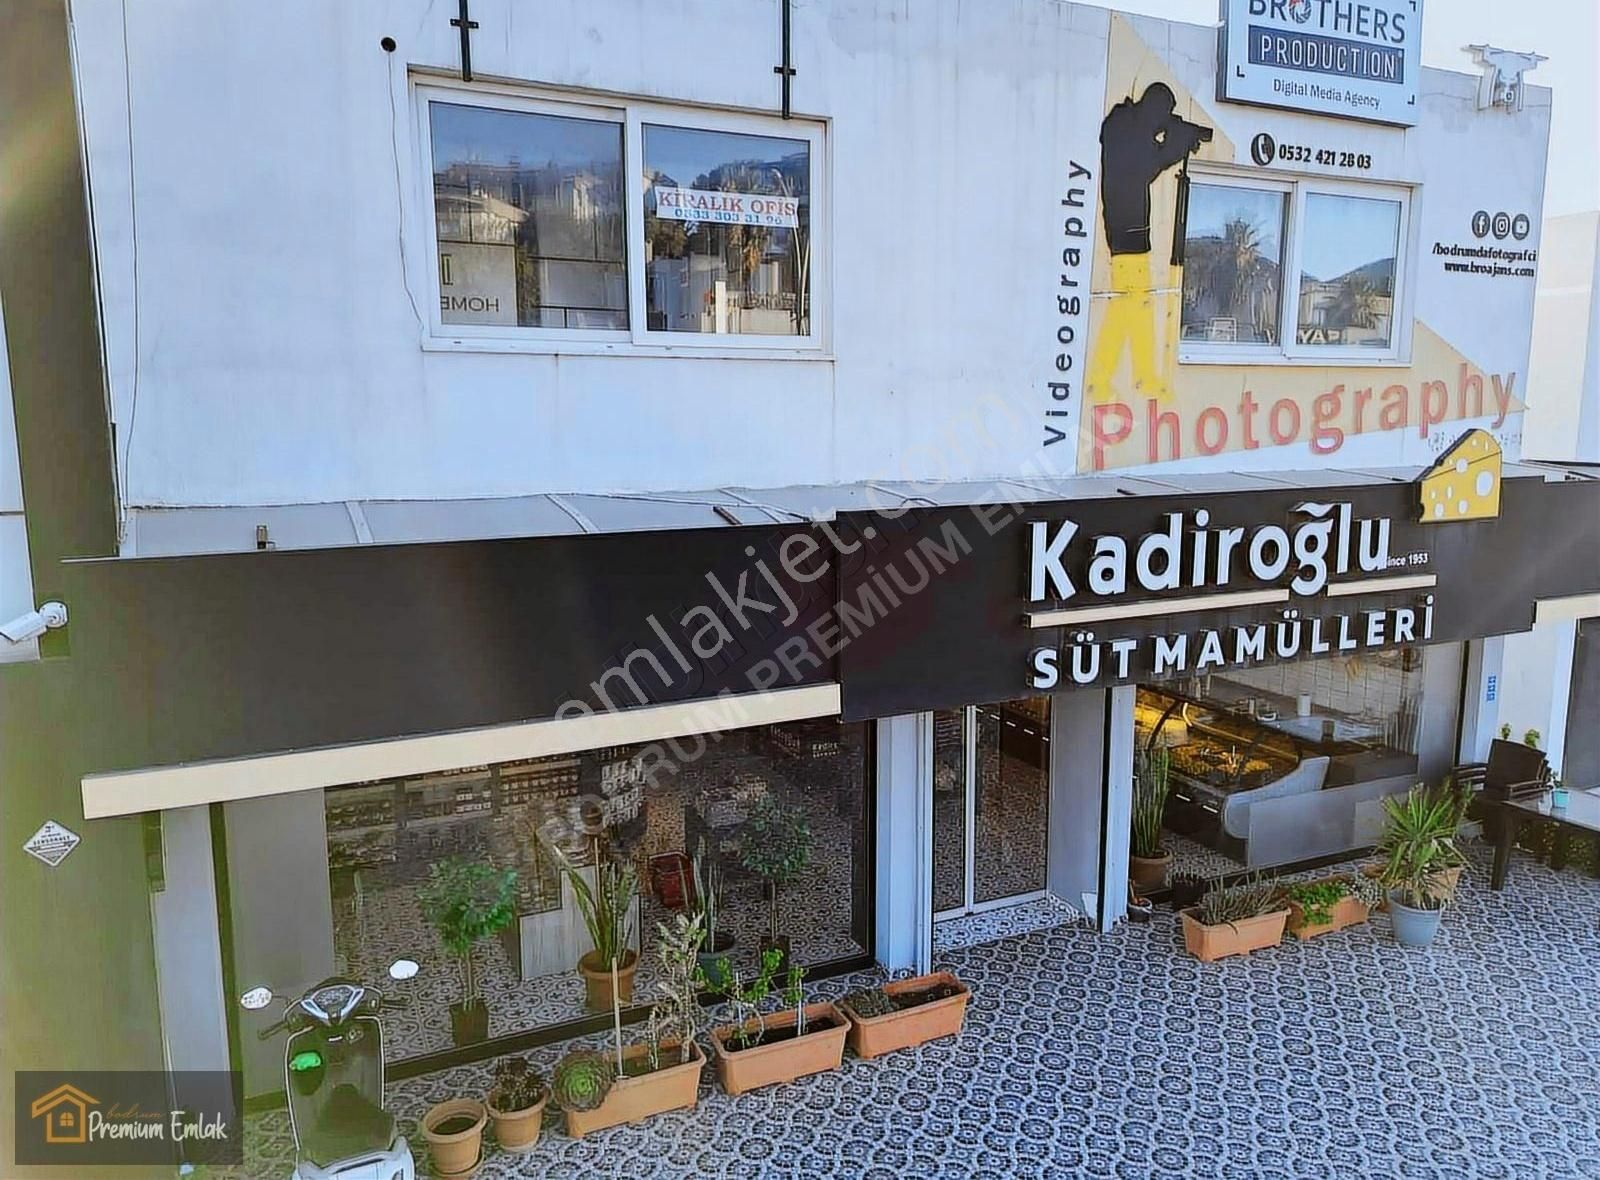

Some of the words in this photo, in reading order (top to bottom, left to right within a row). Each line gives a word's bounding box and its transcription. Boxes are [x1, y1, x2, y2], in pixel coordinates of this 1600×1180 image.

[1261, 35, 1395, 79] PRODUCTION
[1273, 78, 1308, 96] Digital
[1310, 84, 1341, 101] Media
[1344, 90, 1380, 110] Agency
[1279, 144, 1311, 163] 0532
[1315, 149, 1335, 166] 421
[1340, 152, 1355, 168] 28
[1357, 154, 1371, 169] 03
[658, 190, 743, 212] KİRALIK
[750, 198, 796, 216] OFİS
[1043, 160, 1091, 446] Videography
[1091, 363, 1516, 471] Photography
[1031, 502, 1391, 601] Kadiroğlu
[1387, 555, 1406, 567] ince
[1409, 552, 1428, 566] 1953
[1033, 632, 1137, 689] SÜT
[1154, 595, 1434, 674] MAMÜLLERİ
